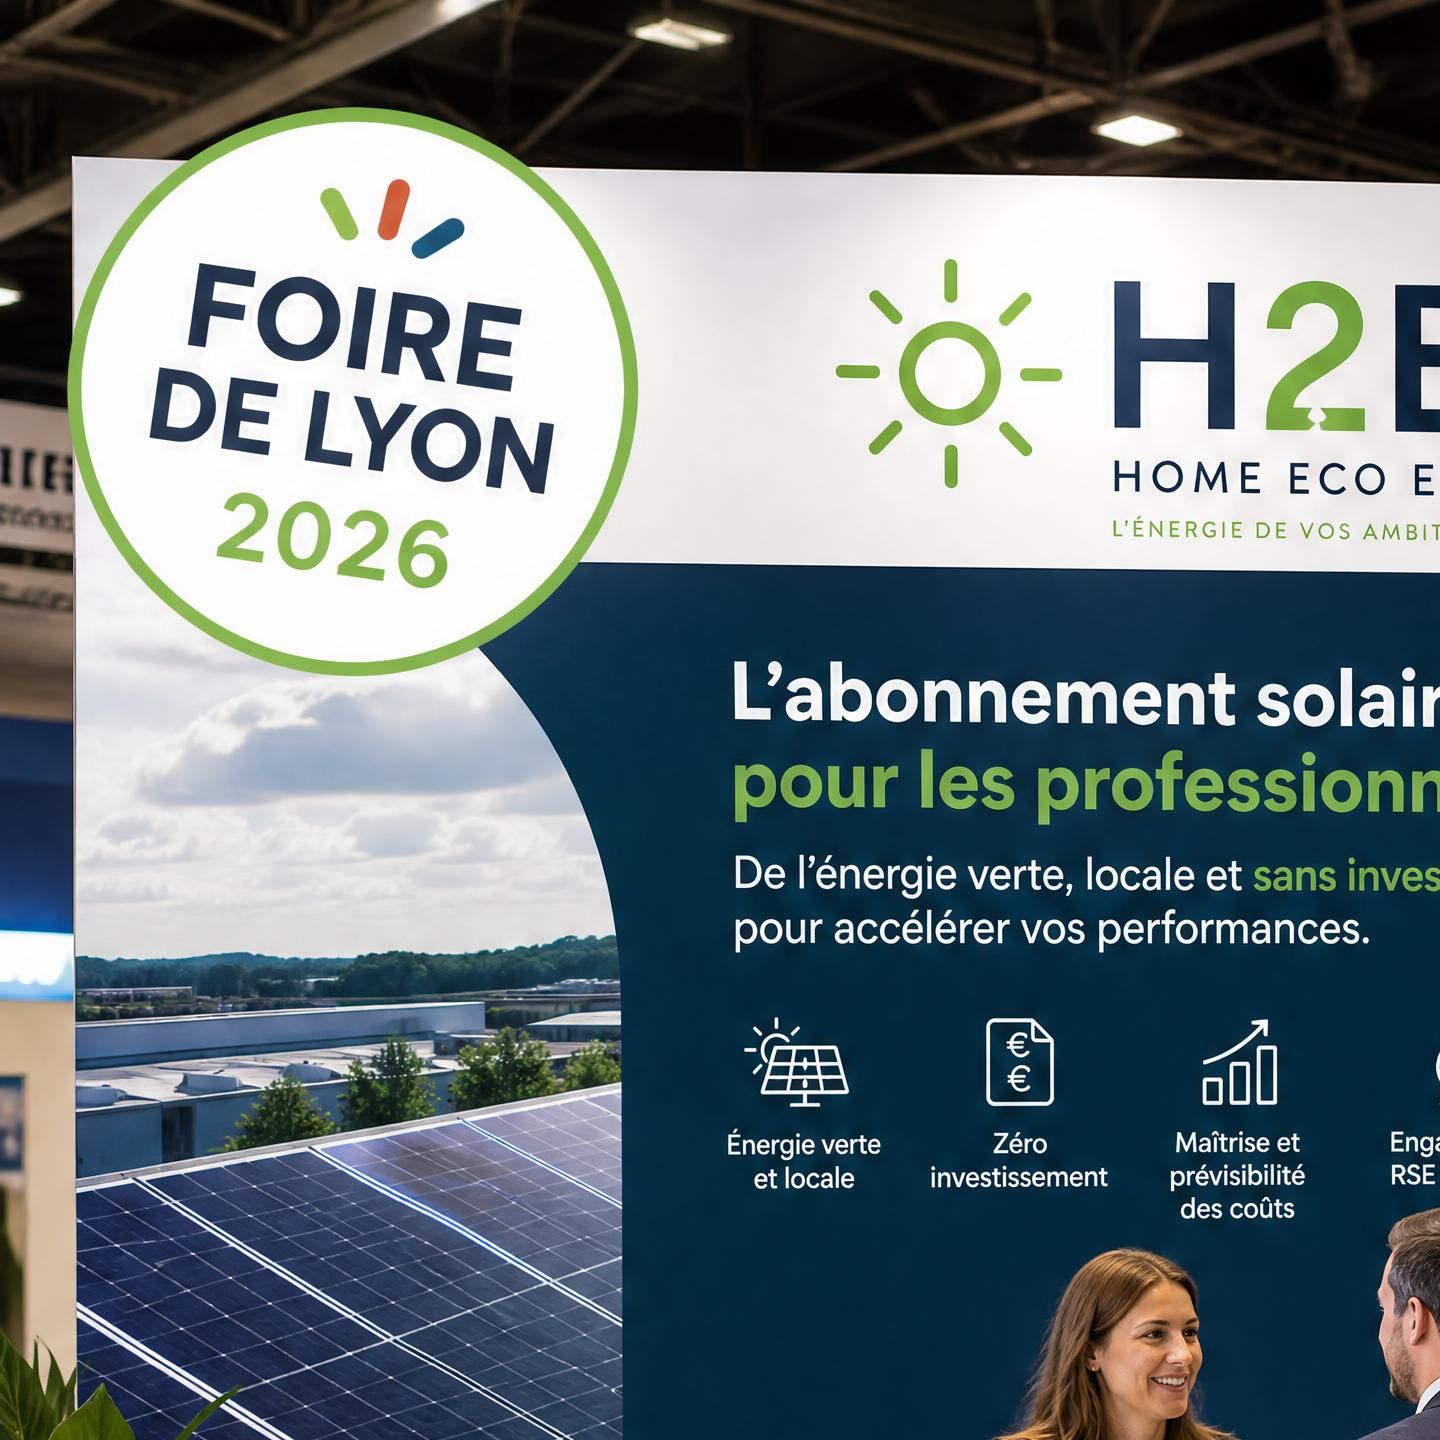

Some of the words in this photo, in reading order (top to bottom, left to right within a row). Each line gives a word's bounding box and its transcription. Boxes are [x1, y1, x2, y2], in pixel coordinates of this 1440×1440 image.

[187, 263, 522, 392] FOIRE
[150, 367, 278, 455] DE
[305, 390, 554, 494] LYON
[1115, 460, 1260, 493] HOME
[1290, 463, 1385, 495] ECO
[216, 492, 448, 588] 2026
[1113, 516, 1242, 538] L’ÉNERGIE
[1256, 522, 1286, 539] DE
[1300, 523, 1350, 540] VOS
[734, 661, 1235, 726] L’abonnement
[735, 764, 898, 822] pour
[921, 749, 1014, 810] les
[736, 855, 785, 889] De
[799, 855, 956, 899] l’énergie
[968, 860, 1072, 896] verte,
[1088, 856, 1194, 891] locale
[1207, 861, 1242, 891] et
[1254, 867, 1336, 891] sans
[736, 919, 823, 953] pour
[835, 910, 1010, 944] accélérer
[1021, 919, 1085, 944] vos
[1099, 909, 1369, 953] performances.
[728, 1129, 815, 1160] Énergie
[822, 1135, 880, 1154] verte
[994, 1132, 1047, 1154] Zéro
[1176, 1131, 1270, 1152] Maîtrise
[1277, 1133, 1300, 1152] et
[754, 1169, 777, 1189] et
[784, 1166, 854, 1189] locale
[931, 1166, 1108, 1188] investissement
[1171, 1164, 1305, 1191] prévisibilité
[1392, 1164, 1435, 1185] RSE
[1181, 1197, 1222, 1219] des
[1230, 1197, 1294, 1219] coûts
